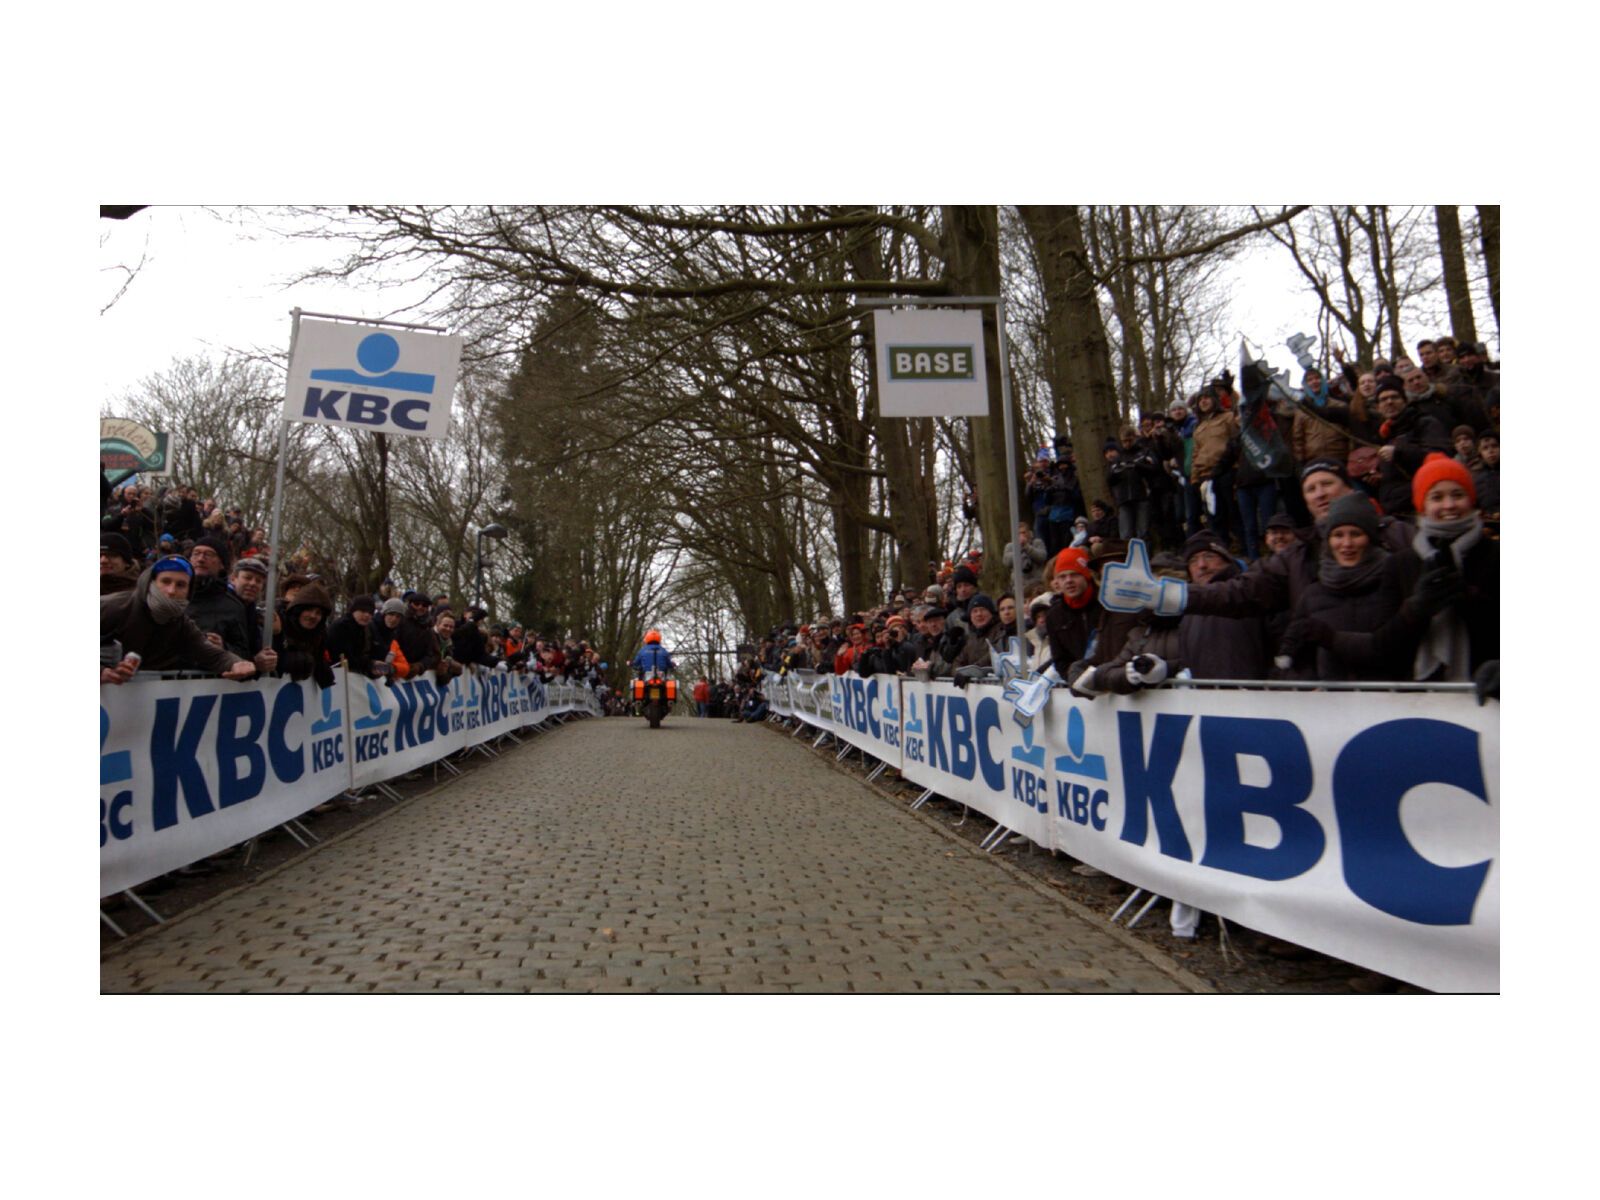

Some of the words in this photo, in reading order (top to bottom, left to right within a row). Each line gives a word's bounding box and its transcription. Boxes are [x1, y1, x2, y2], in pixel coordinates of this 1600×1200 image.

[896, 352, 967, 373] BASE
[303, 387, 431, 431] KBC
[391, 679, 449, 752] KBC
[479, 671, 508, 726] KBC
[840, 677, 881, 739] KBC
[151, 682, 304, 832] KBC
[312, 733, 344, 773] KBC
[355, 729, 388, 763] KBC
[883, 723, 900, 747] KBC
[905, 736, 924, 763] KBC
[925, 694, 1005, 792] KBC
[1012, 767, 1048, 814] KBC
[1056, 779, 1109, 832] KBC
[1117, 710, 1494, 926] KBC
